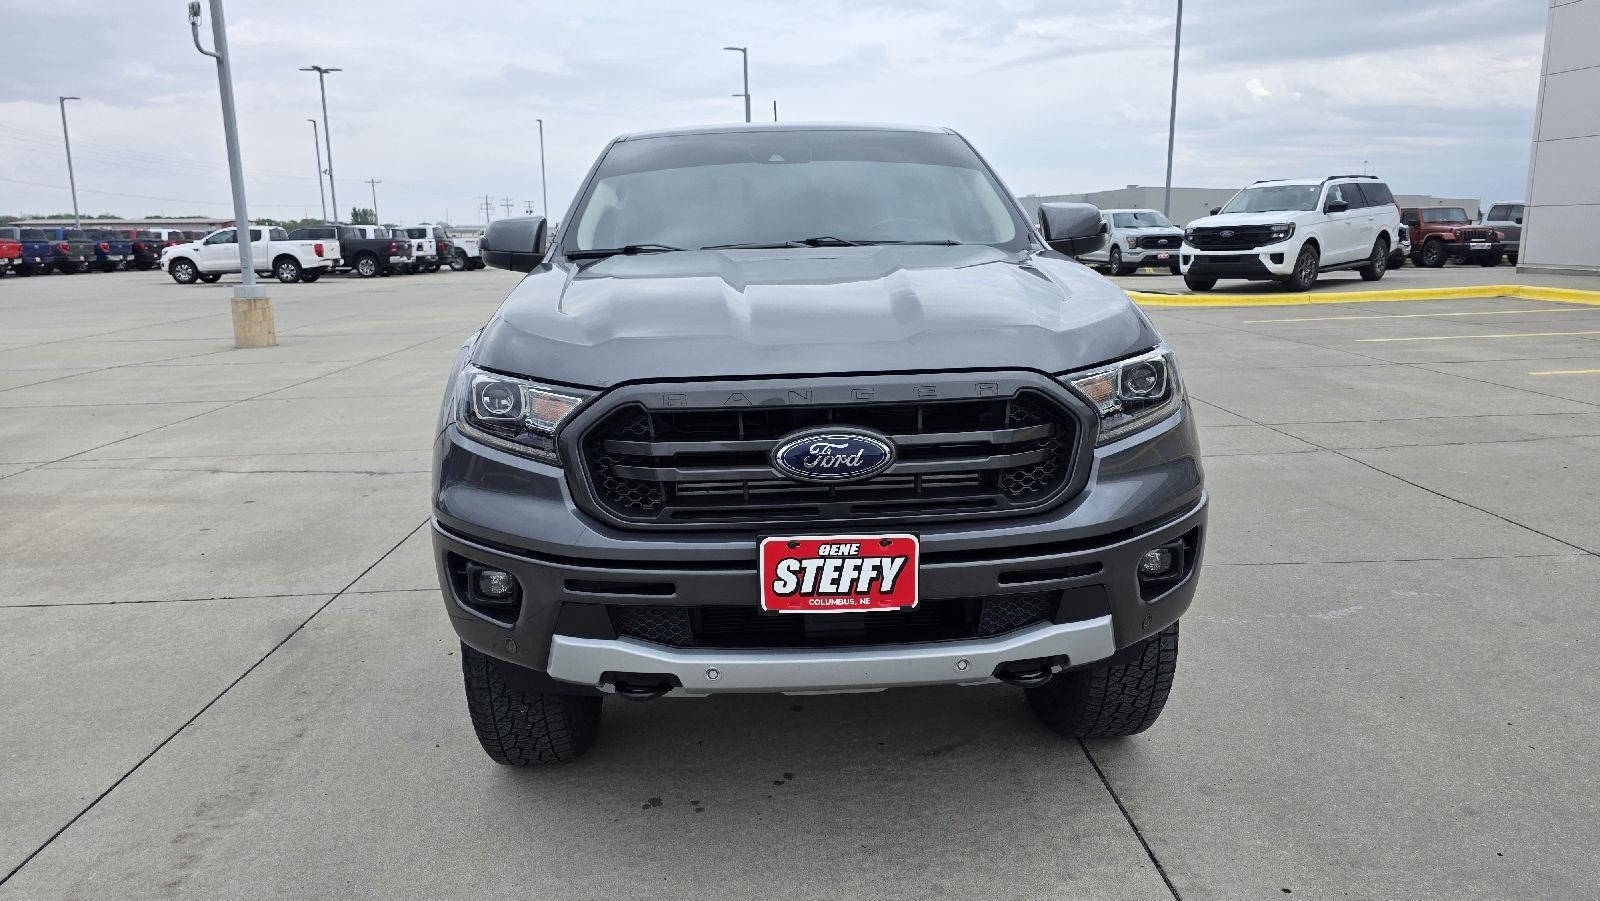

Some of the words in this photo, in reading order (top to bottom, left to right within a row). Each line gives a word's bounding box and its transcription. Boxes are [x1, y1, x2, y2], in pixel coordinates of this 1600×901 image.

[662, 382, 999, 407] RANGER
[803, 442, 865, 469] Ford
[818, 542, 861, 556] GENE
[773, 556, 907, 595] STEFFY
[808, 598, 857, 606] COLUMBUS,
